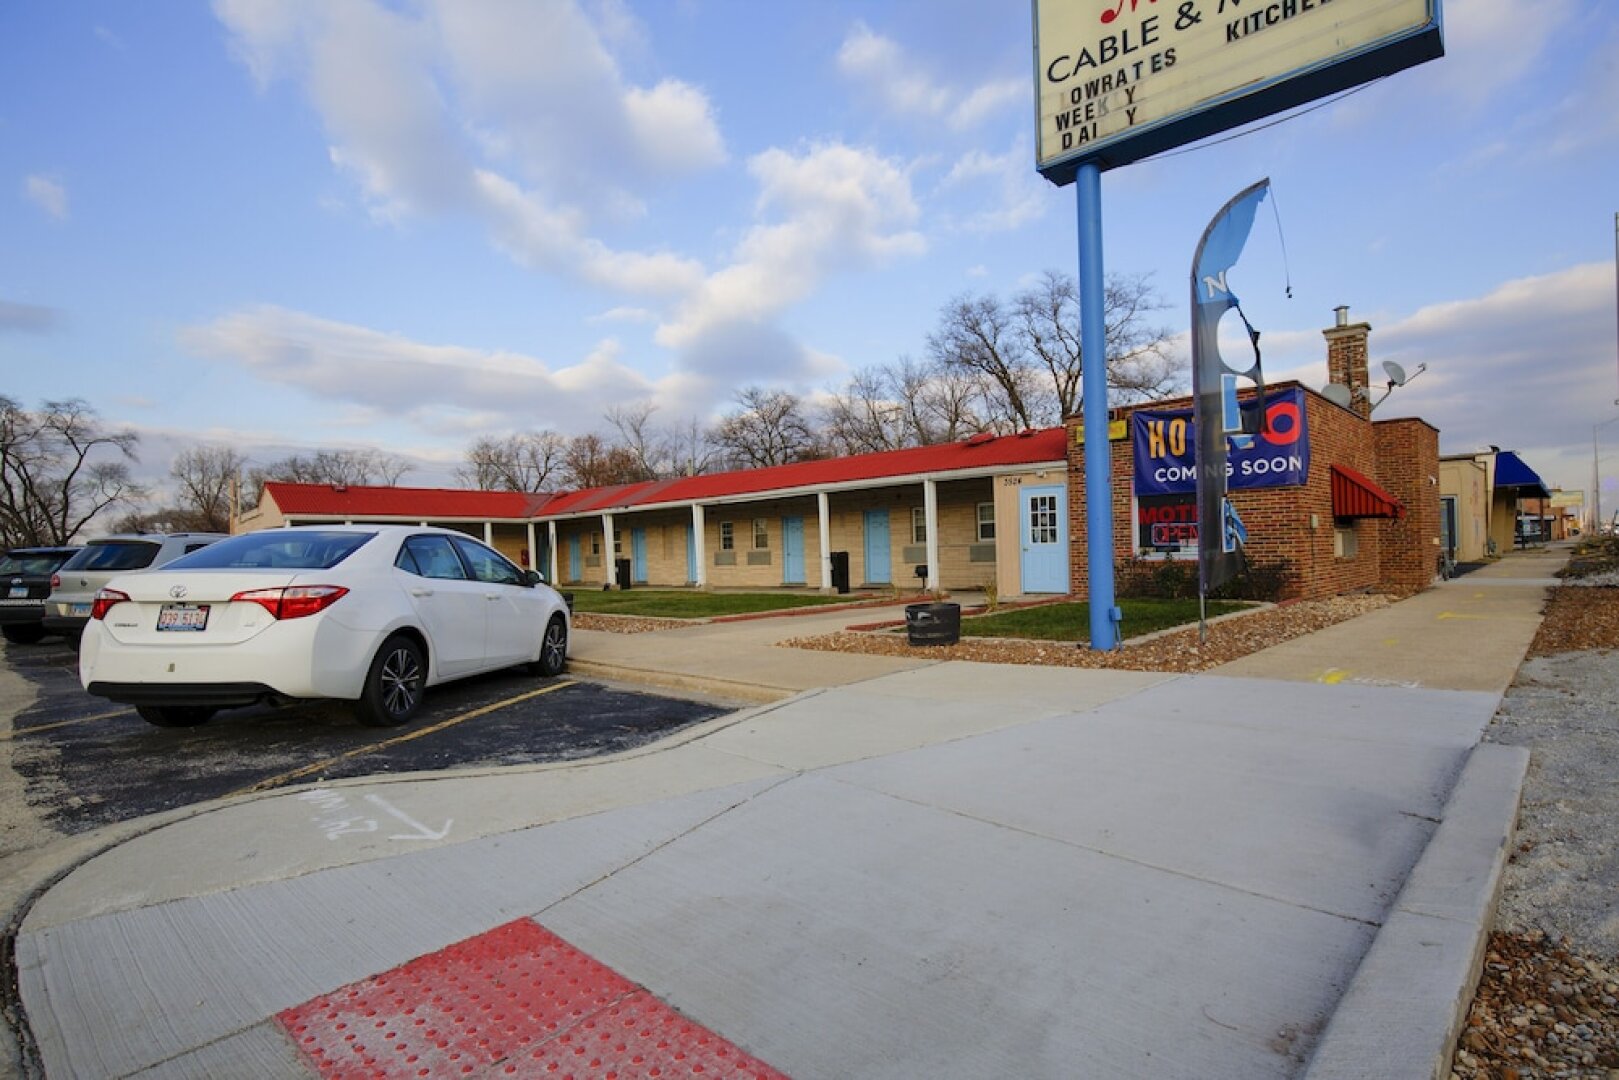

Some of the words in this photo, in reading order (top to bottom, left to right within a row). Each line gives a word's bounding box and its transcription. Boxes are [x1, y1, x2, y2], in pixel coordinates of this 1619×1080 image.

[1226, 0, 1332, 42] KITCHE
[1047, 15, 1159, 83] CABLE
[1174, 1, 1202, 31] &
[1155, 456, 1235, 482] COMNG
[1241, 455, 1303, 476] SOON
[1138, 504, 1198, 526] MOT
